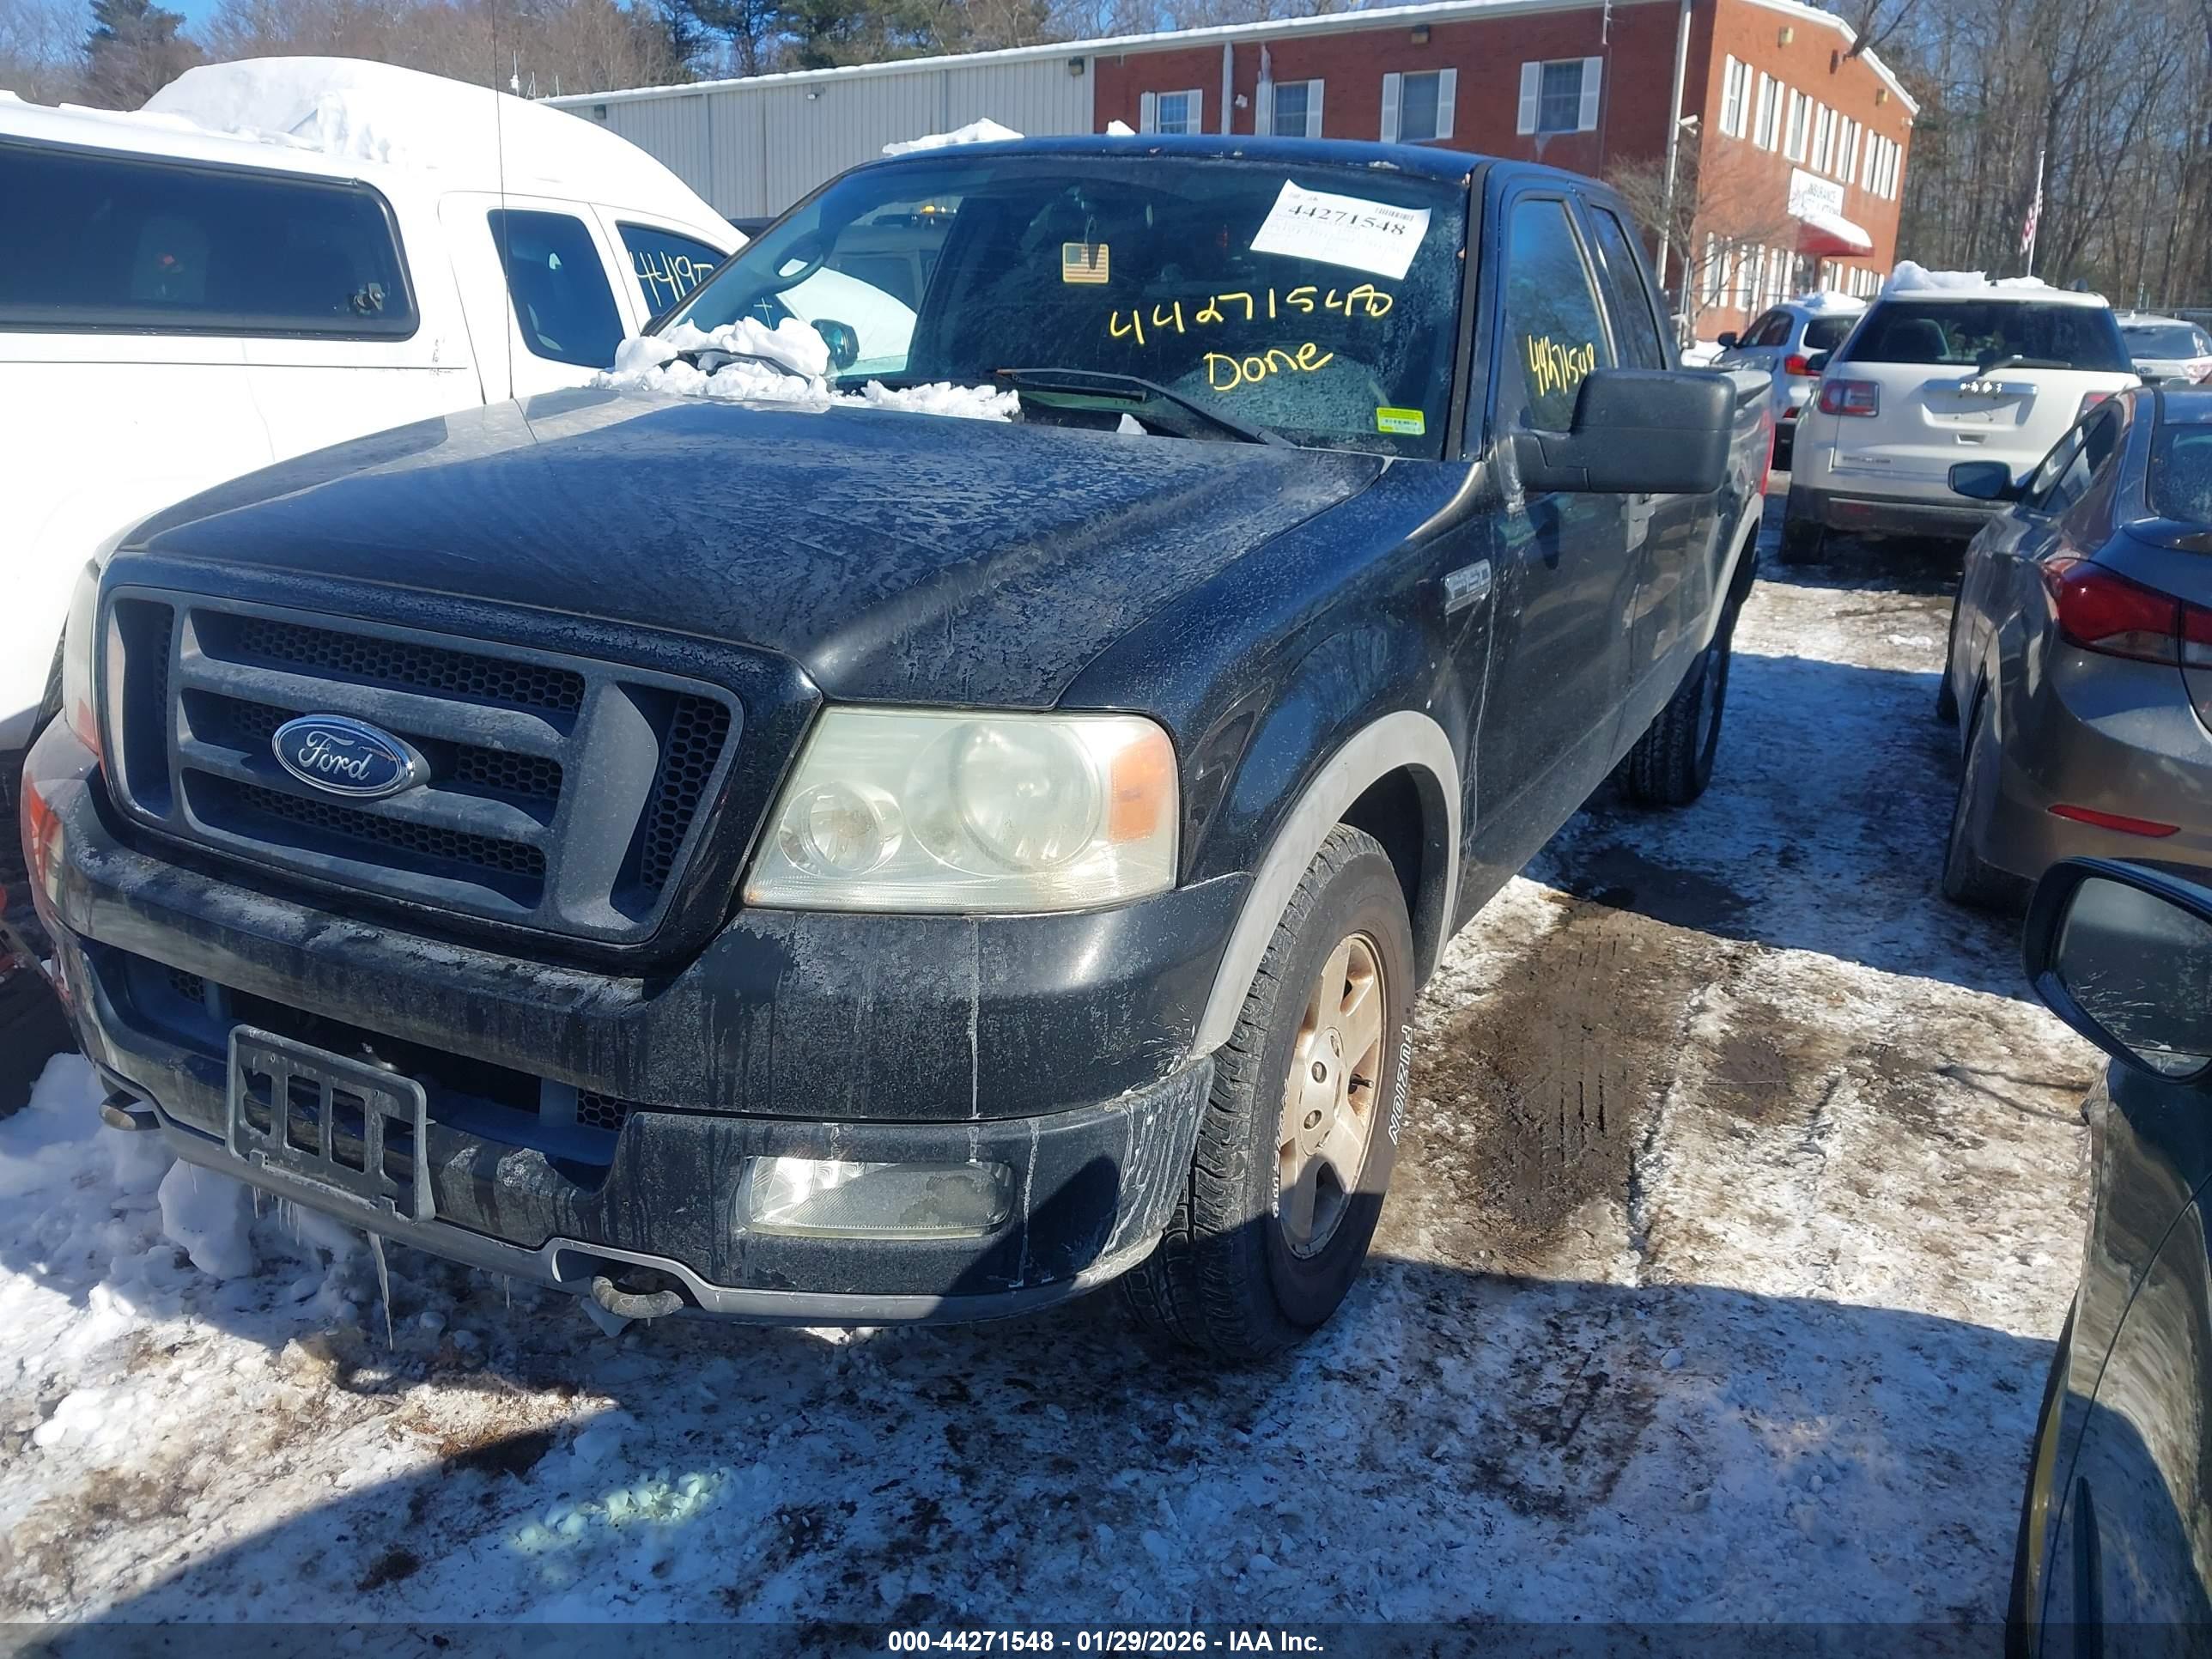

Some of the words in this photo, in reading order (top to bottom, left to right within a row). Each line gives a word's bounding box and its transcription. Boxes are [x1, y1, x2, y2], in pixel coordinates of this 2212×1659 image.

[1288, 204, 1407, 235] 44271548
[1204, 343, 1334, 392] Done
[298, 731, 373, 781] Ford
[1388, 1024, 1413, 1146] FUZION
